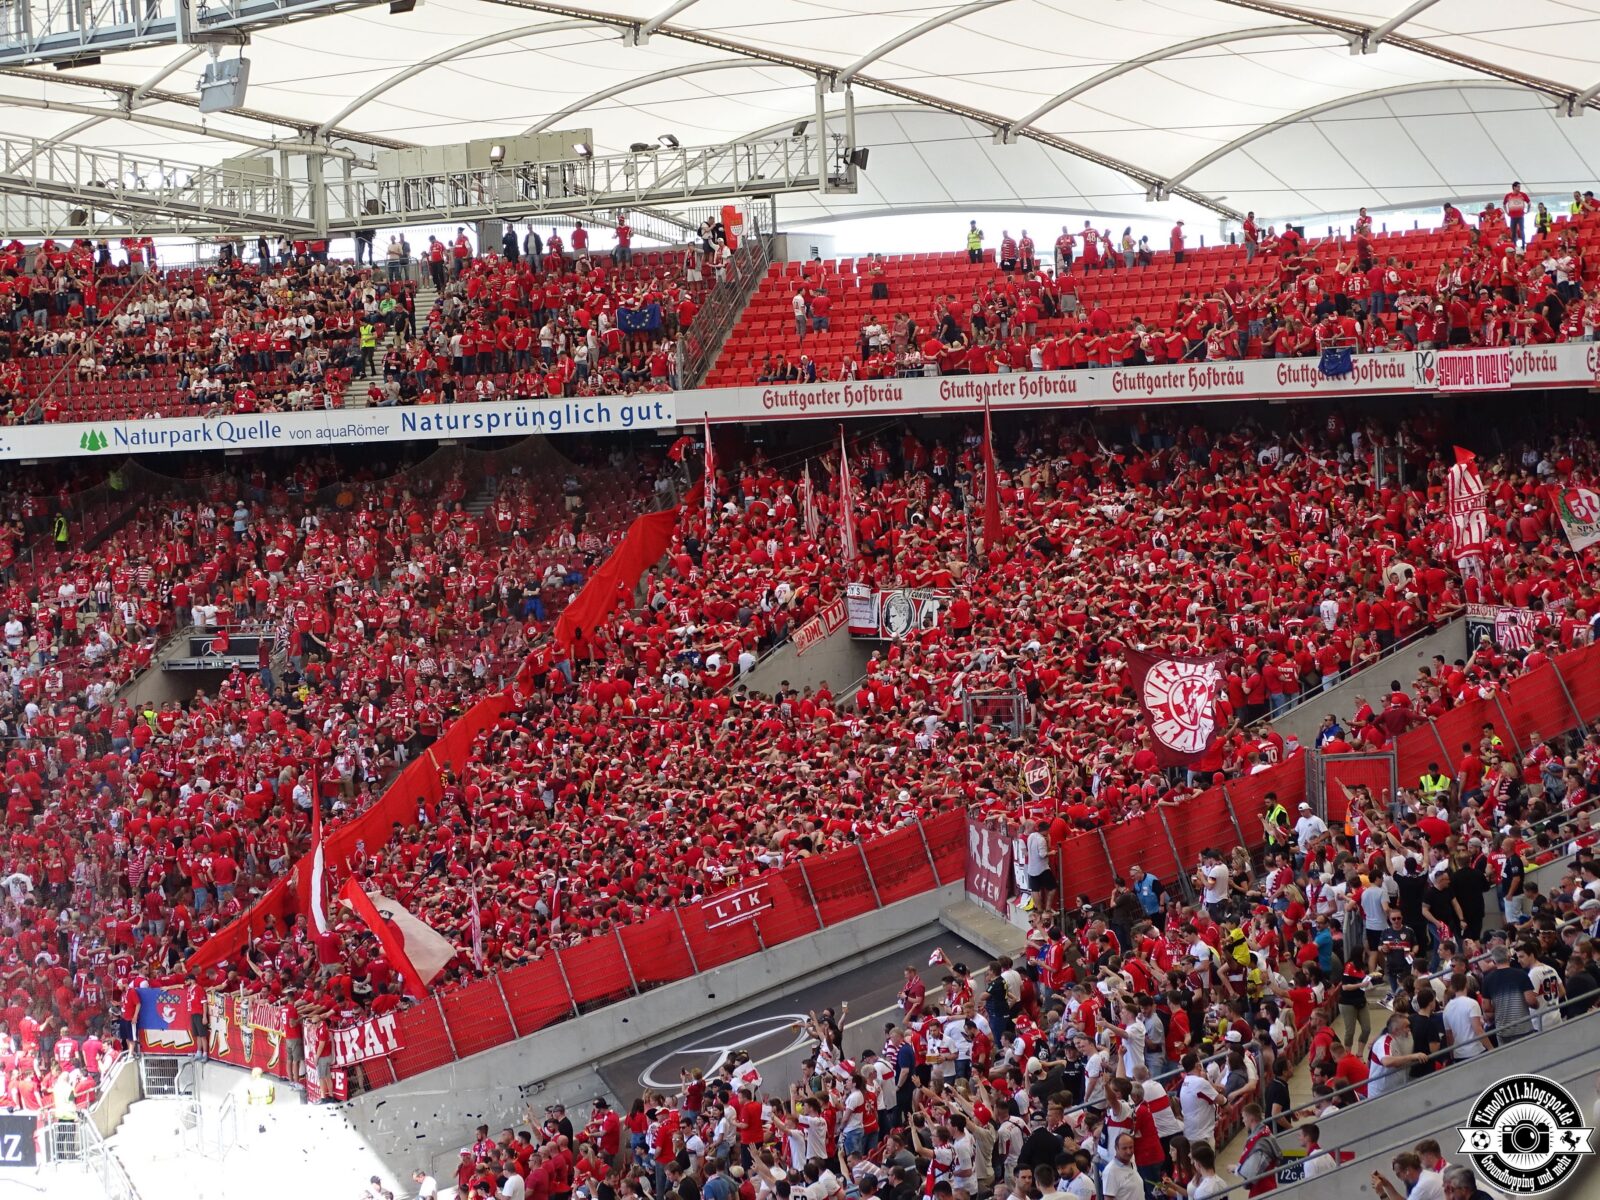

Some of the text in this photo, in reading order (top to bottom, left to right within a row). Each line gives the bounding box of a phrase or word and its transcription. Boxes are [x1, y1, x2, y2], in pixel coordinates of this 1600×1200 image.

[939, 375, 1077, 404] Stuttgarter Hofbräu
[1112, 366, 1244, 395] Stuttgarter Hofbräu
[762, 384, 903, 411] Stuttgarter Hofbräu
[402, 401, 672, 434] Natursprünglich gut.
[114, 420, 281, 447] Naturpark Quelle
[289, 423, 389, 443] von aquaRömer
